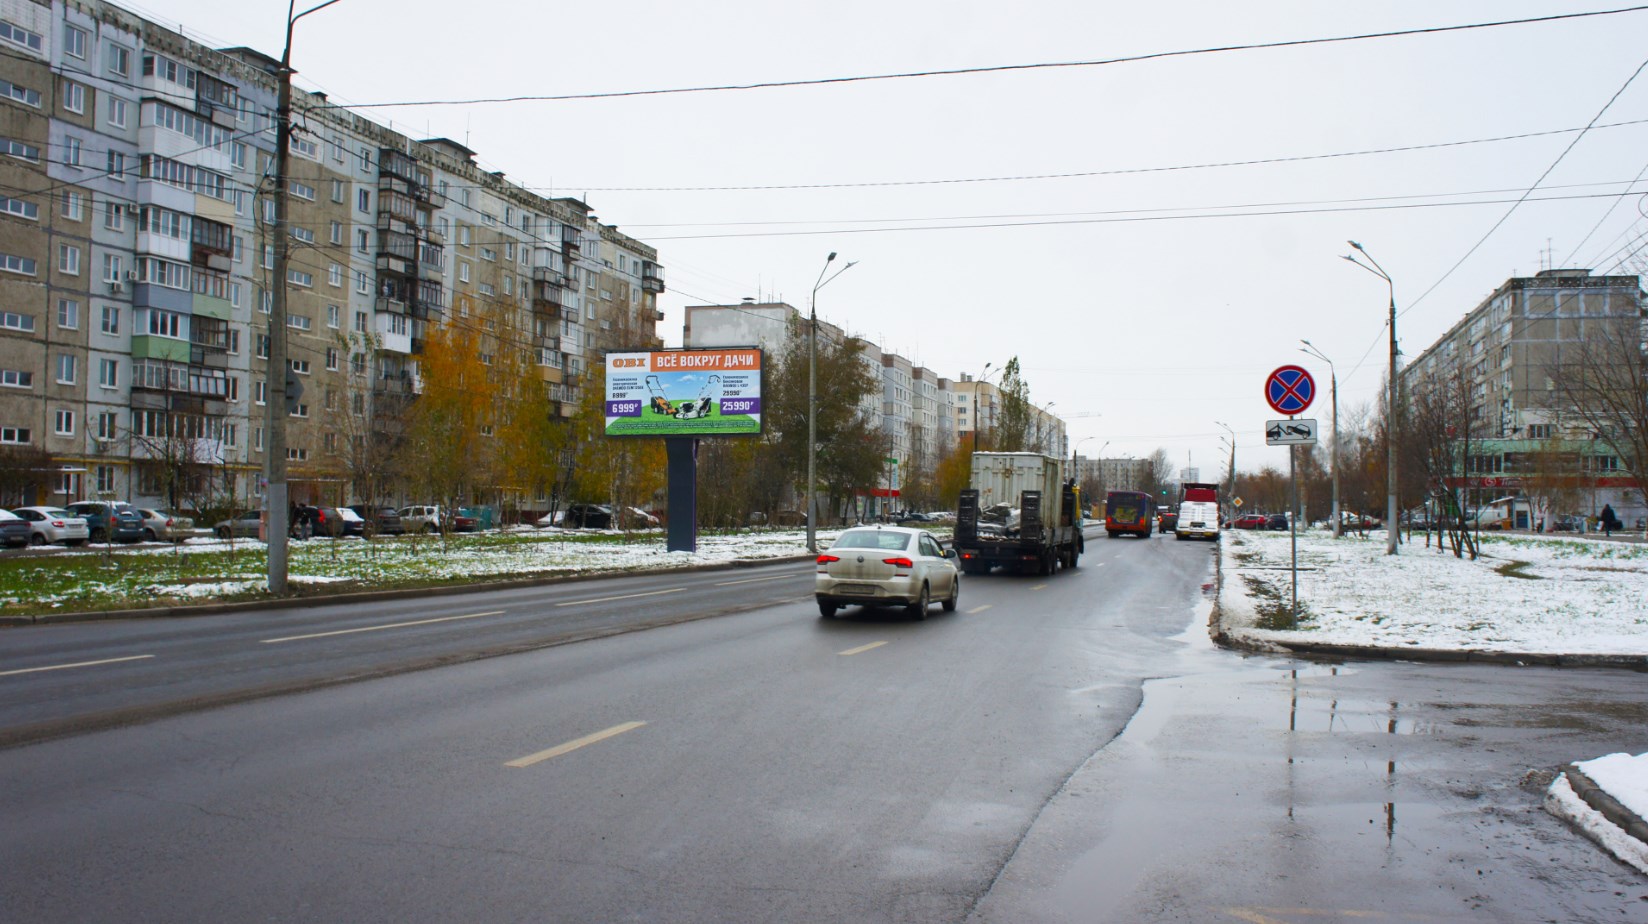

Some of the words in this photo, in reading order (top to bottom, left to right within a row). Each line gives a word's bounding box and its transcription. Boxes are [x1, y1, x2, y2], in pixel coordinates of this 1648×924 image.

[613, 358, 646, 368] OBI
[657, 354, 677, 367] ВСЁ
[680, 355, 721, 367] ВОКРУГ
[724, 354, 754, 367] ДАЧИ
